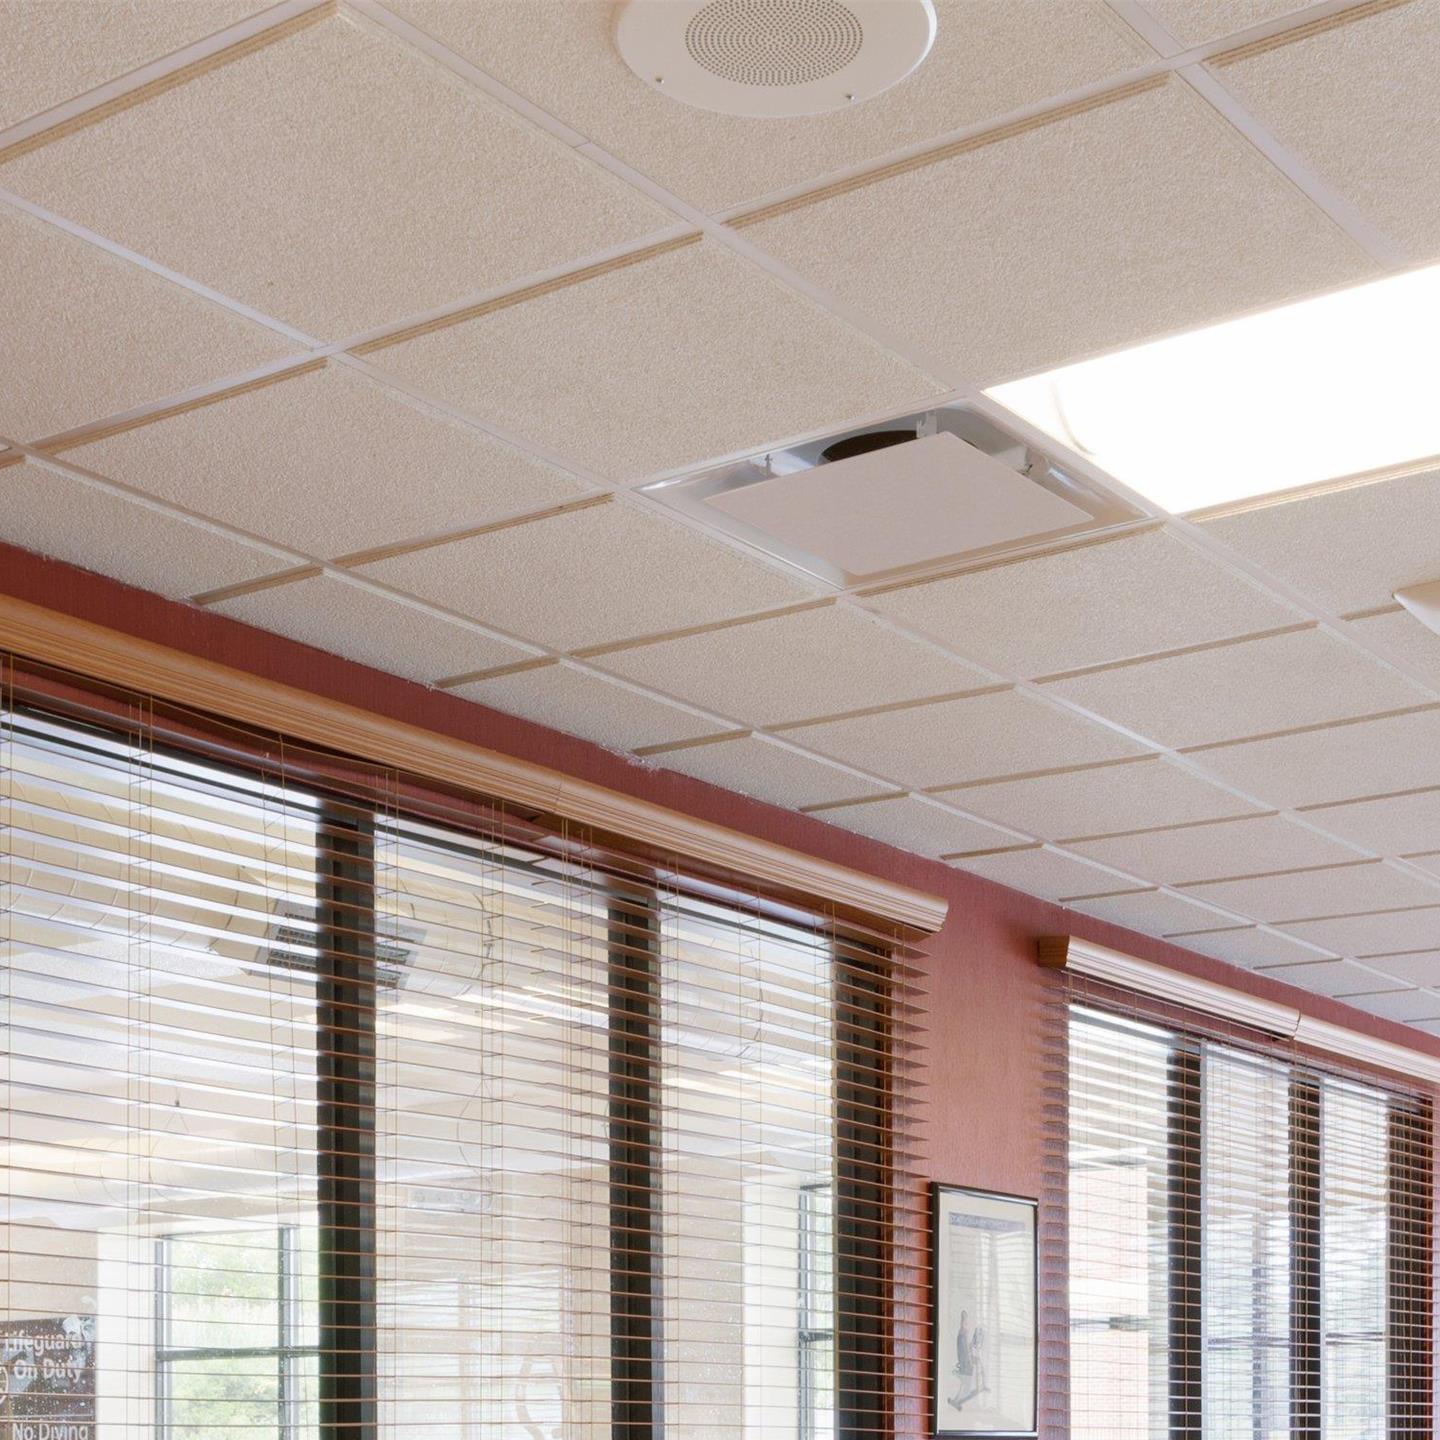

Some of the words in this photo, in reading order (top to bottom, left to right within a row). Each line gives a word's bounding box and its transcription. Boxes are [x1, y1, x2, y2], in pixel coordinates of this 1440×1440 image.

[14, 1359, 37, 1379] On
[43, 1356, 81, 1383] Duty
[12, 1423, 33, 1440] No
